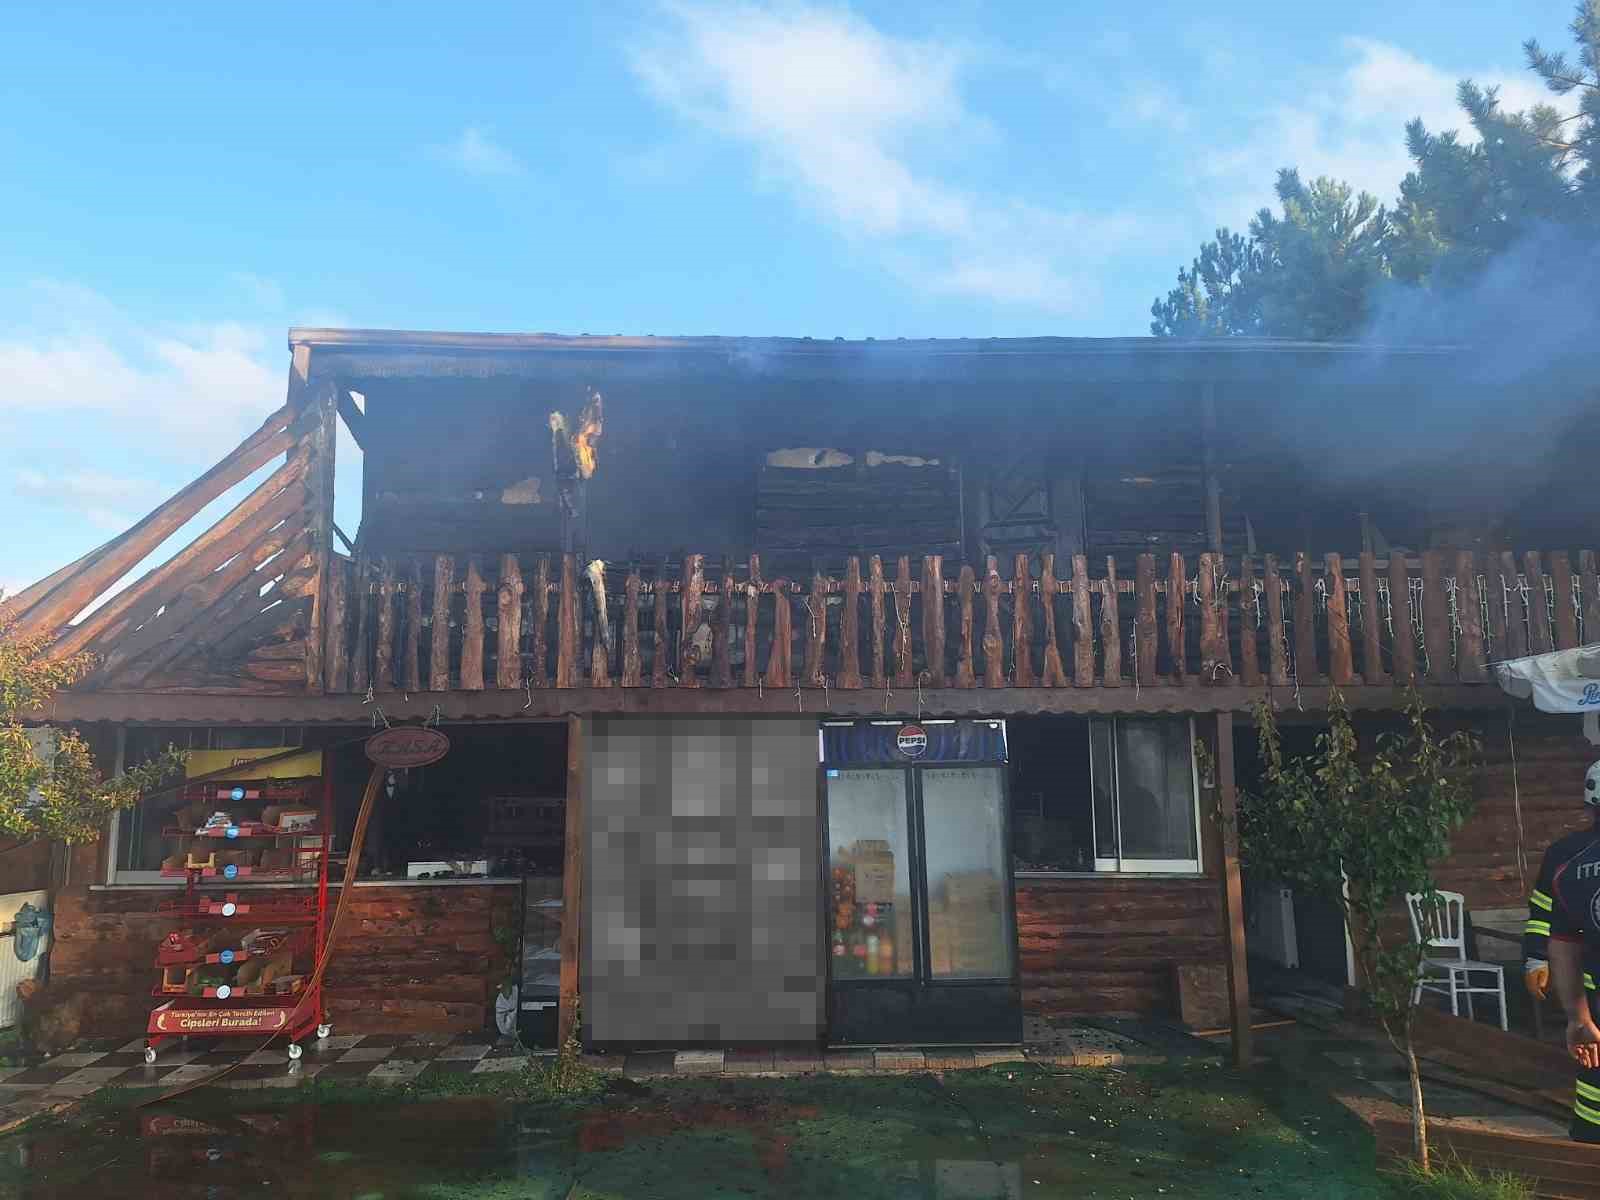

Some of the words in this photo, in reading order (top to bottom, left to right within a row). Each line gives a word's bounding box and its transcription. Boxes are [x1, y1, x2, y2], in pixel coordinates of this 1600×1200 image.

[899, 736, 926, 745] PEPSI
[180, 1018, 219, 1029] Cipsleri
[221, 1017, 262, 1027] Burada!
